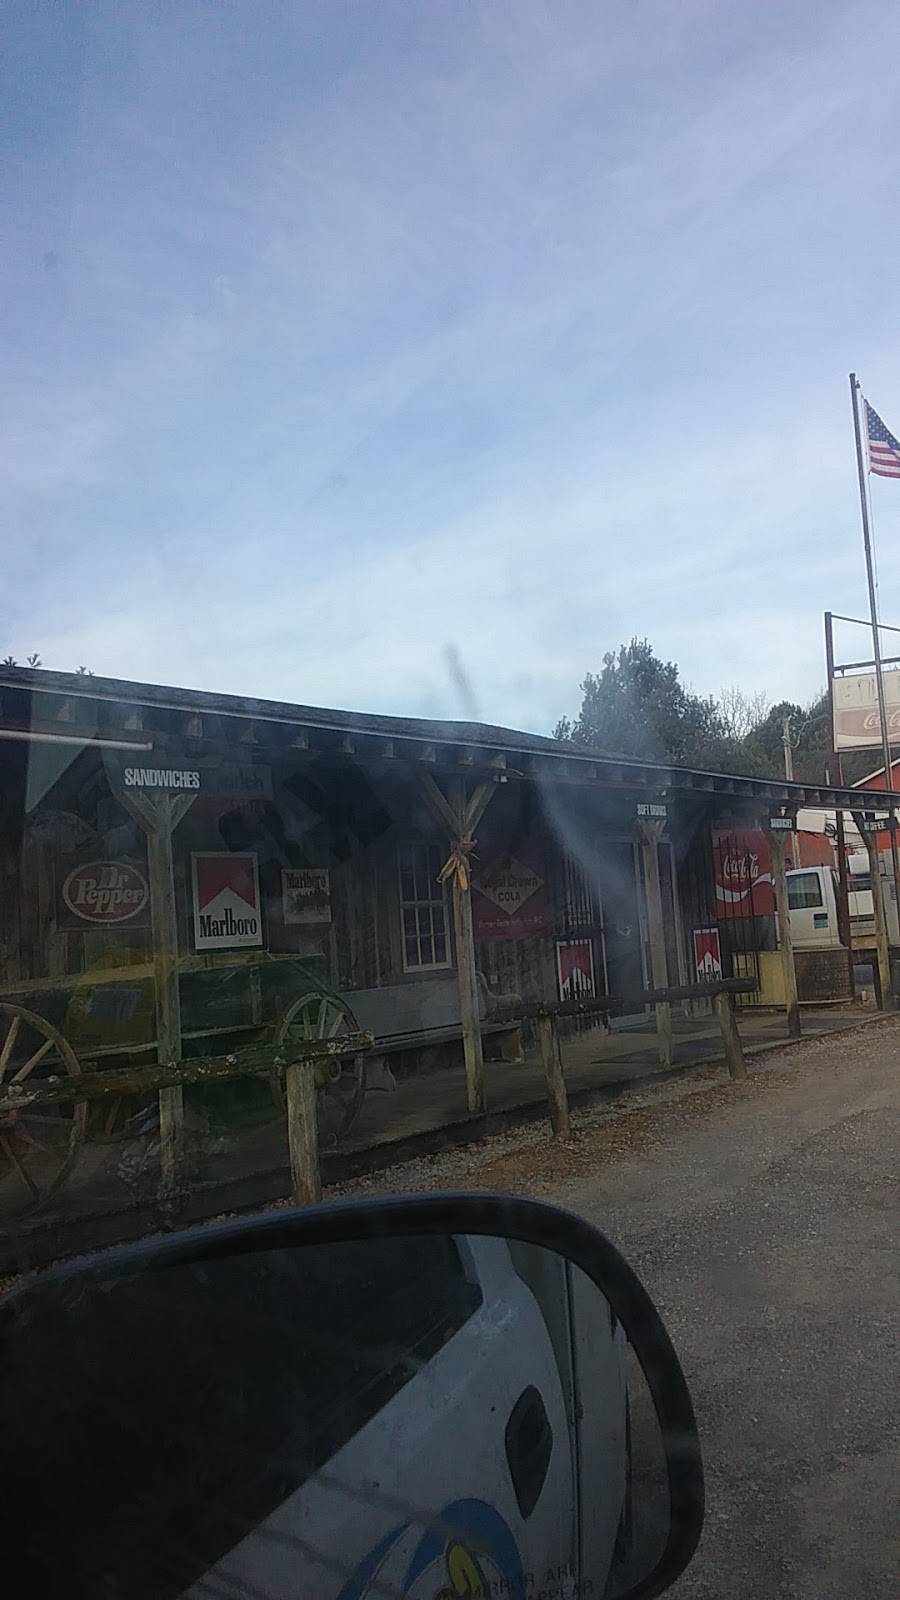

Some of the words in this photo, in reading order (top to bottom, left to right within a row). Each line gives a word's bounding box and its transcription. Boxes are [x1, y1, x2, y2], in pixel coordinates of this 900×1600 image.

[124, 768, 201, 789] SANDWICHES
[98, 866, 129, 889] Dr
[74, 878, 145, 913] Pepper
[497, 891, 521, 902] COLA
[199, 908, 257, 938] Marlboro
